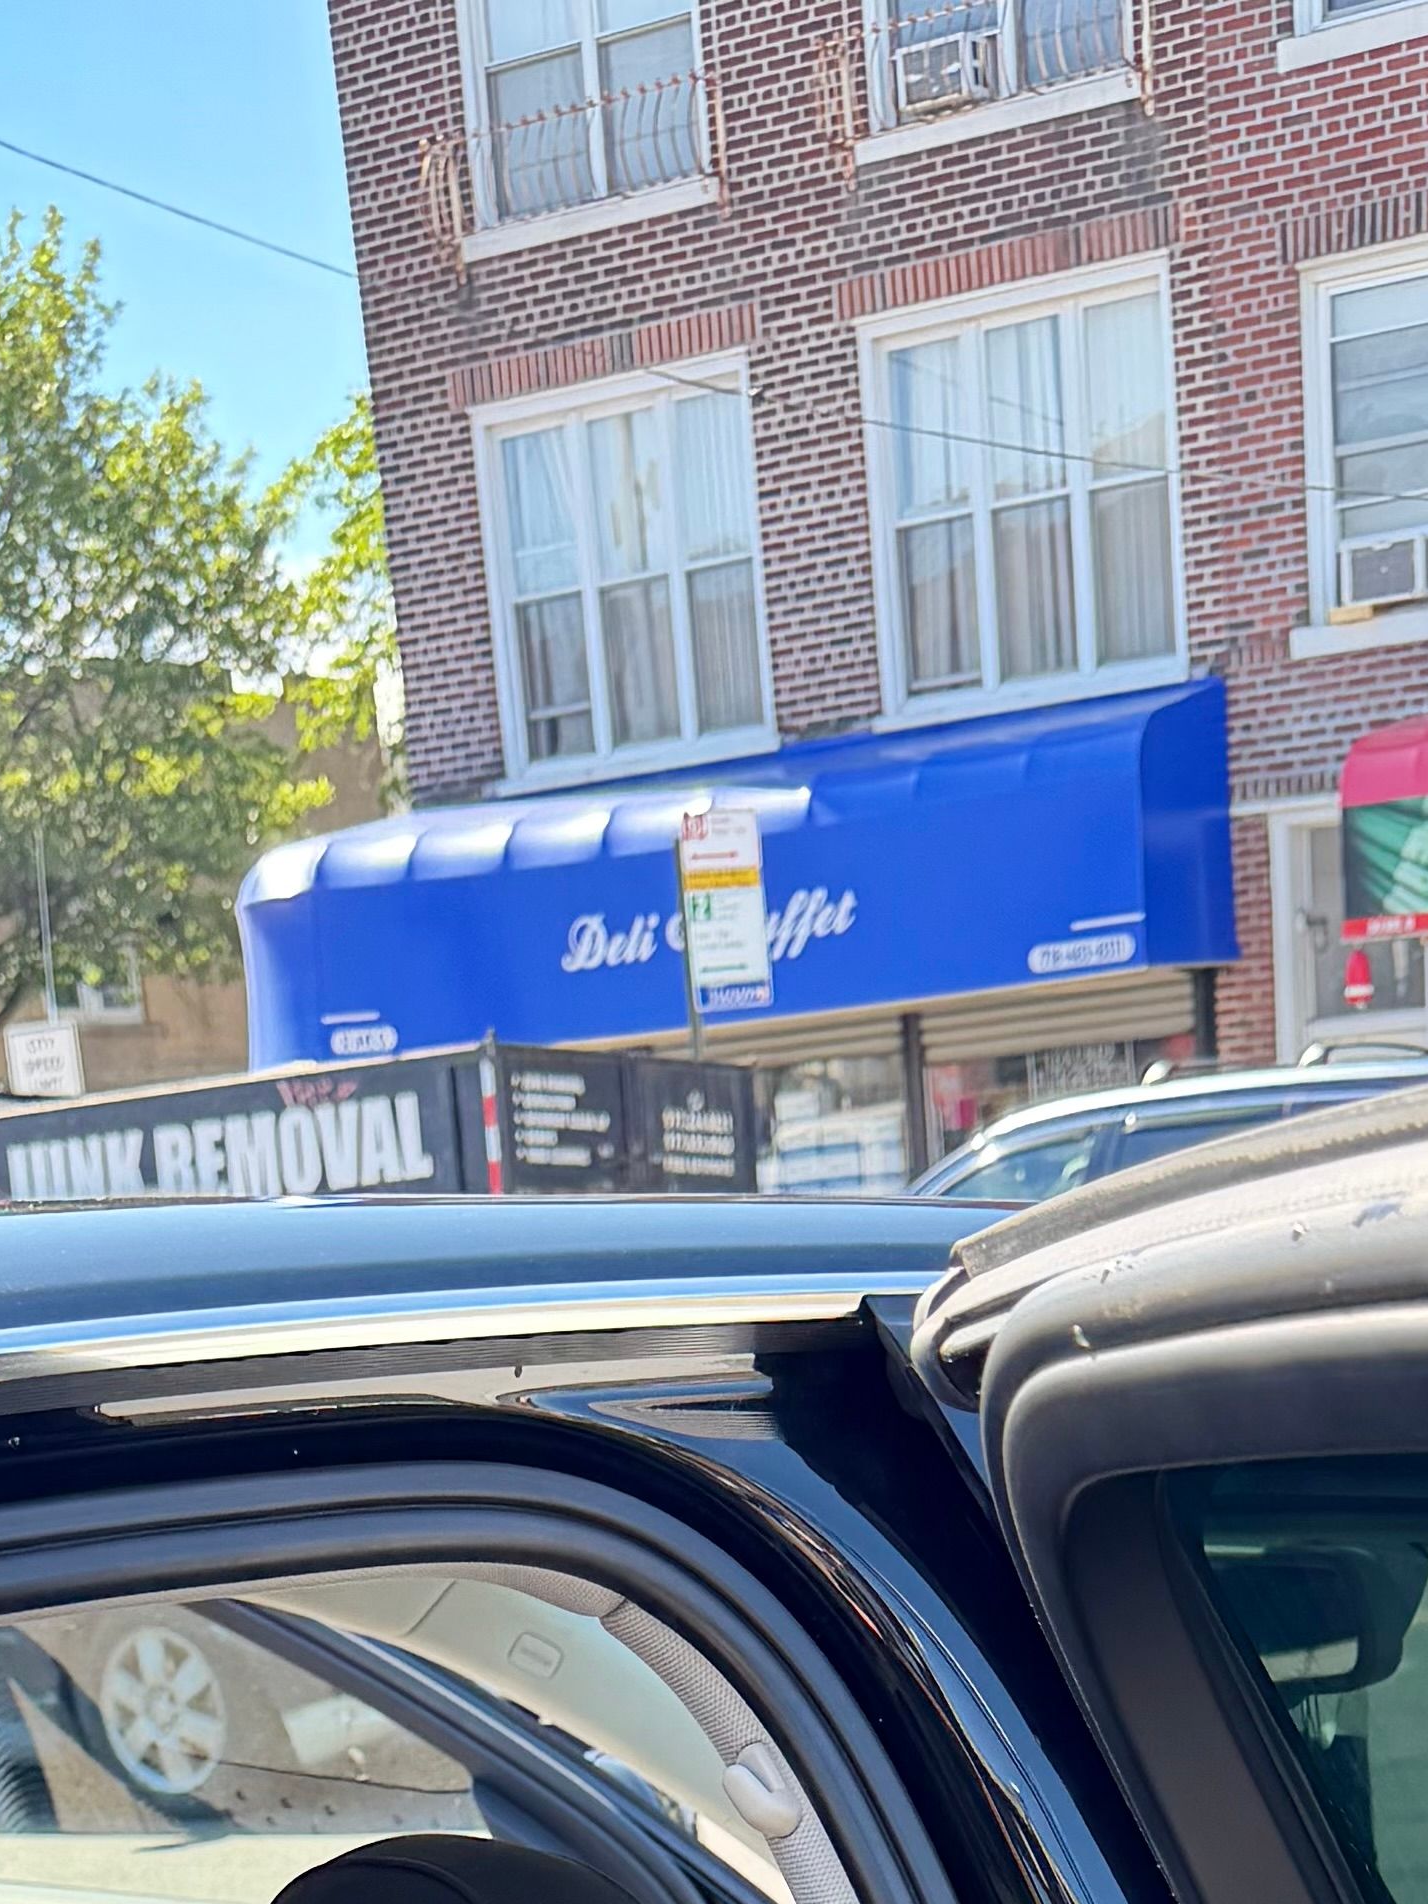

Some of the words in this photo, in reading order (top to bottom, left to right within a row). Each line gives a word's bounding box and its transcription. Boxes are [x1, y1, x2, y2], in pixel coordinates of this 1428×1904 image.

[561, 913, 660, 973] Deli
[766, 886, 858, 962] ffet
[153, 1090, 434, 1197] REMOVAL
